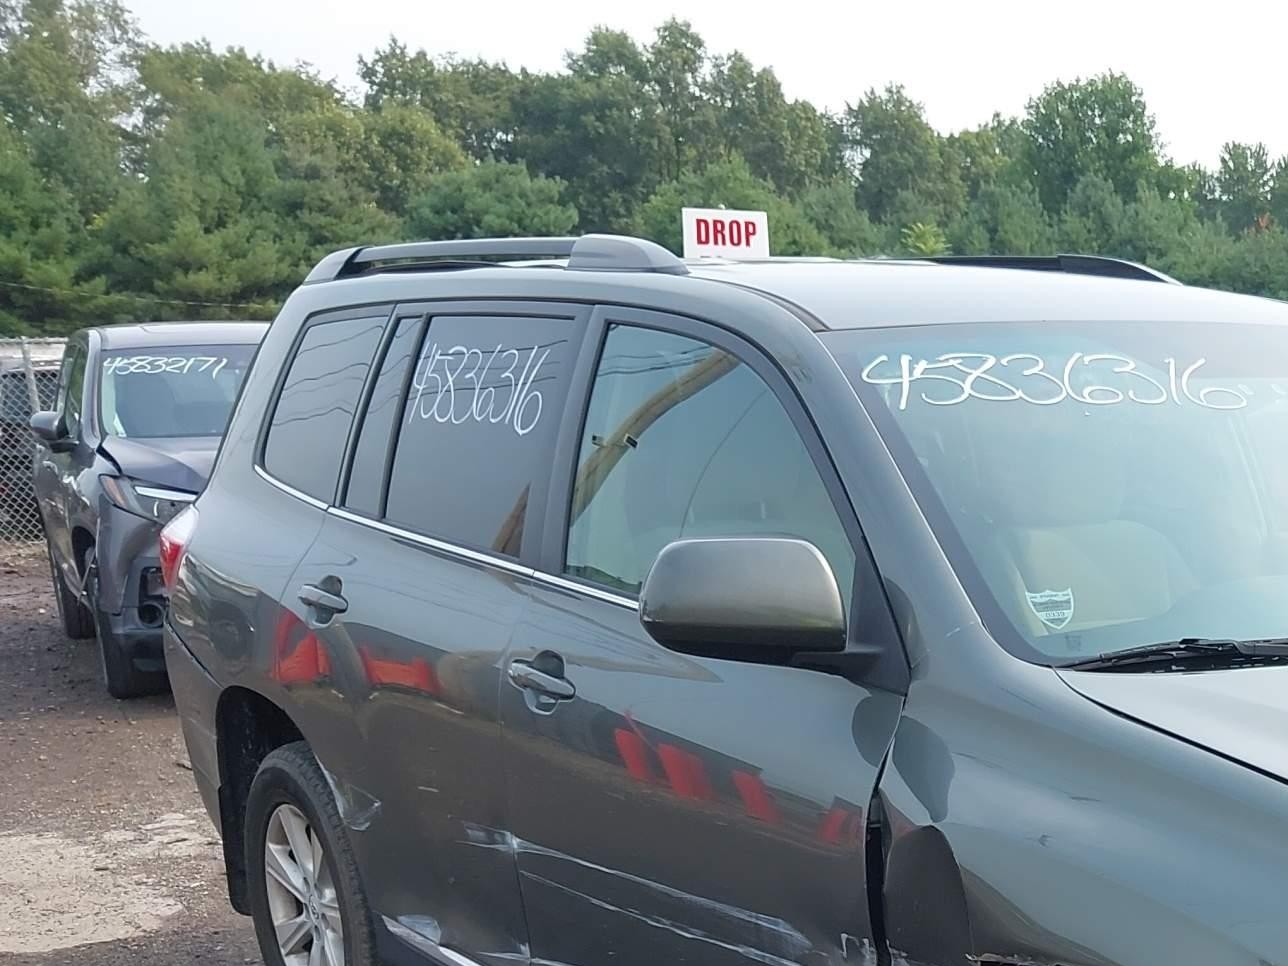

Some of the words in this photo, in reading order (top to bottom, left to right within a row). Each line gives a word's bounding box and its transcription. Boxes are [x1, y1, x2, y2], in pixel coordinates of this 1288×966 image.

[695, 218, 756, 248] DROP
[408, 341, 551, 436] 45836316
[860, 352, 1249, 410] 45836316
